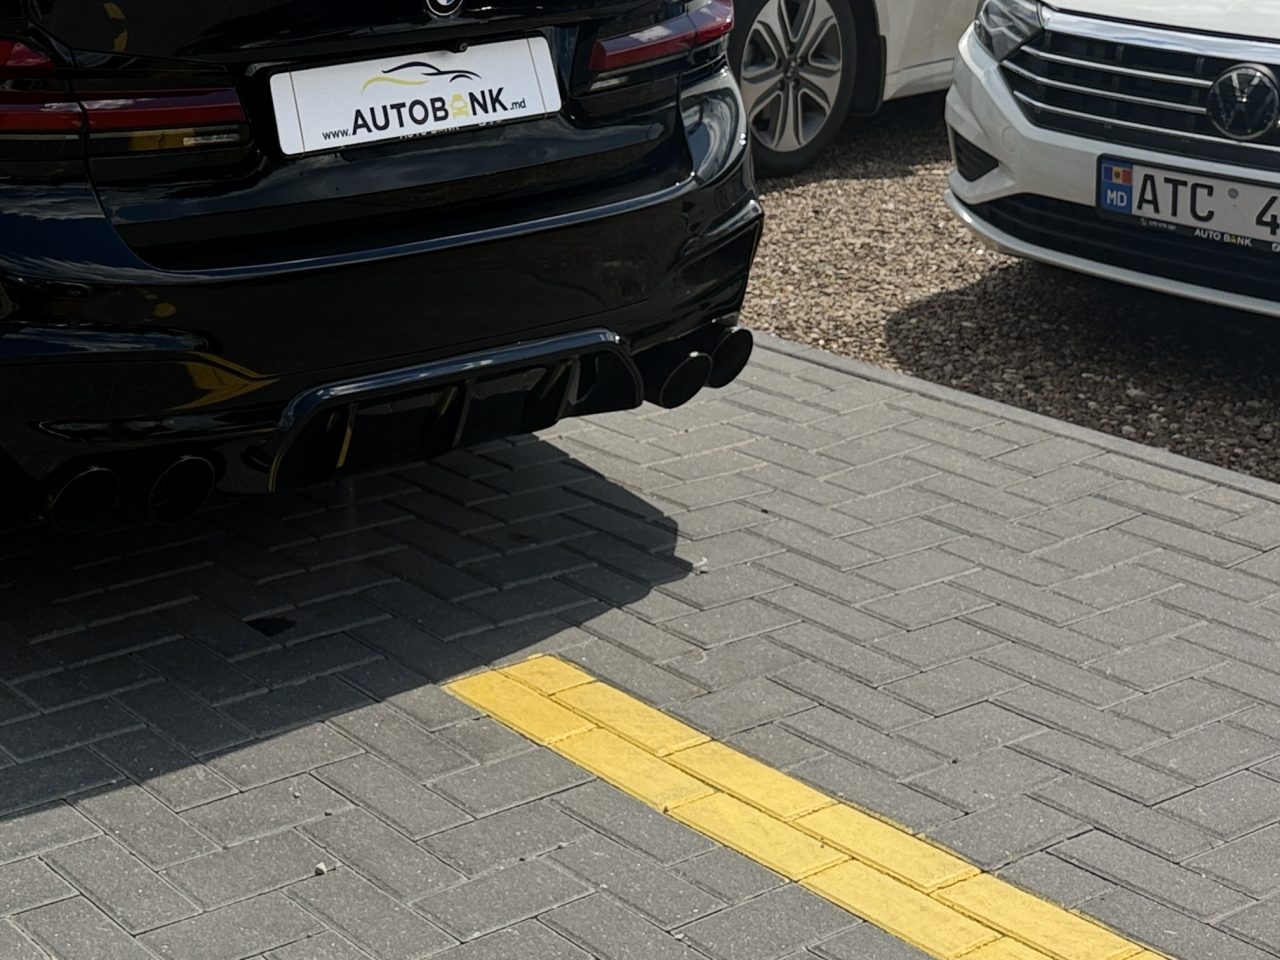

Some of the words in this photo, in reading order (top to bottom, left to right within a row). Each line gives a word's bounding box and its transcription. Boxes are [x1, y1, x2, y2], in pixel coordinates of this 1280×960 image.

[1106, 189, 1127, 207] MD
[1136, 173, 1215, 223] ATC
[1194, 228, 1221, 241] AUTO
